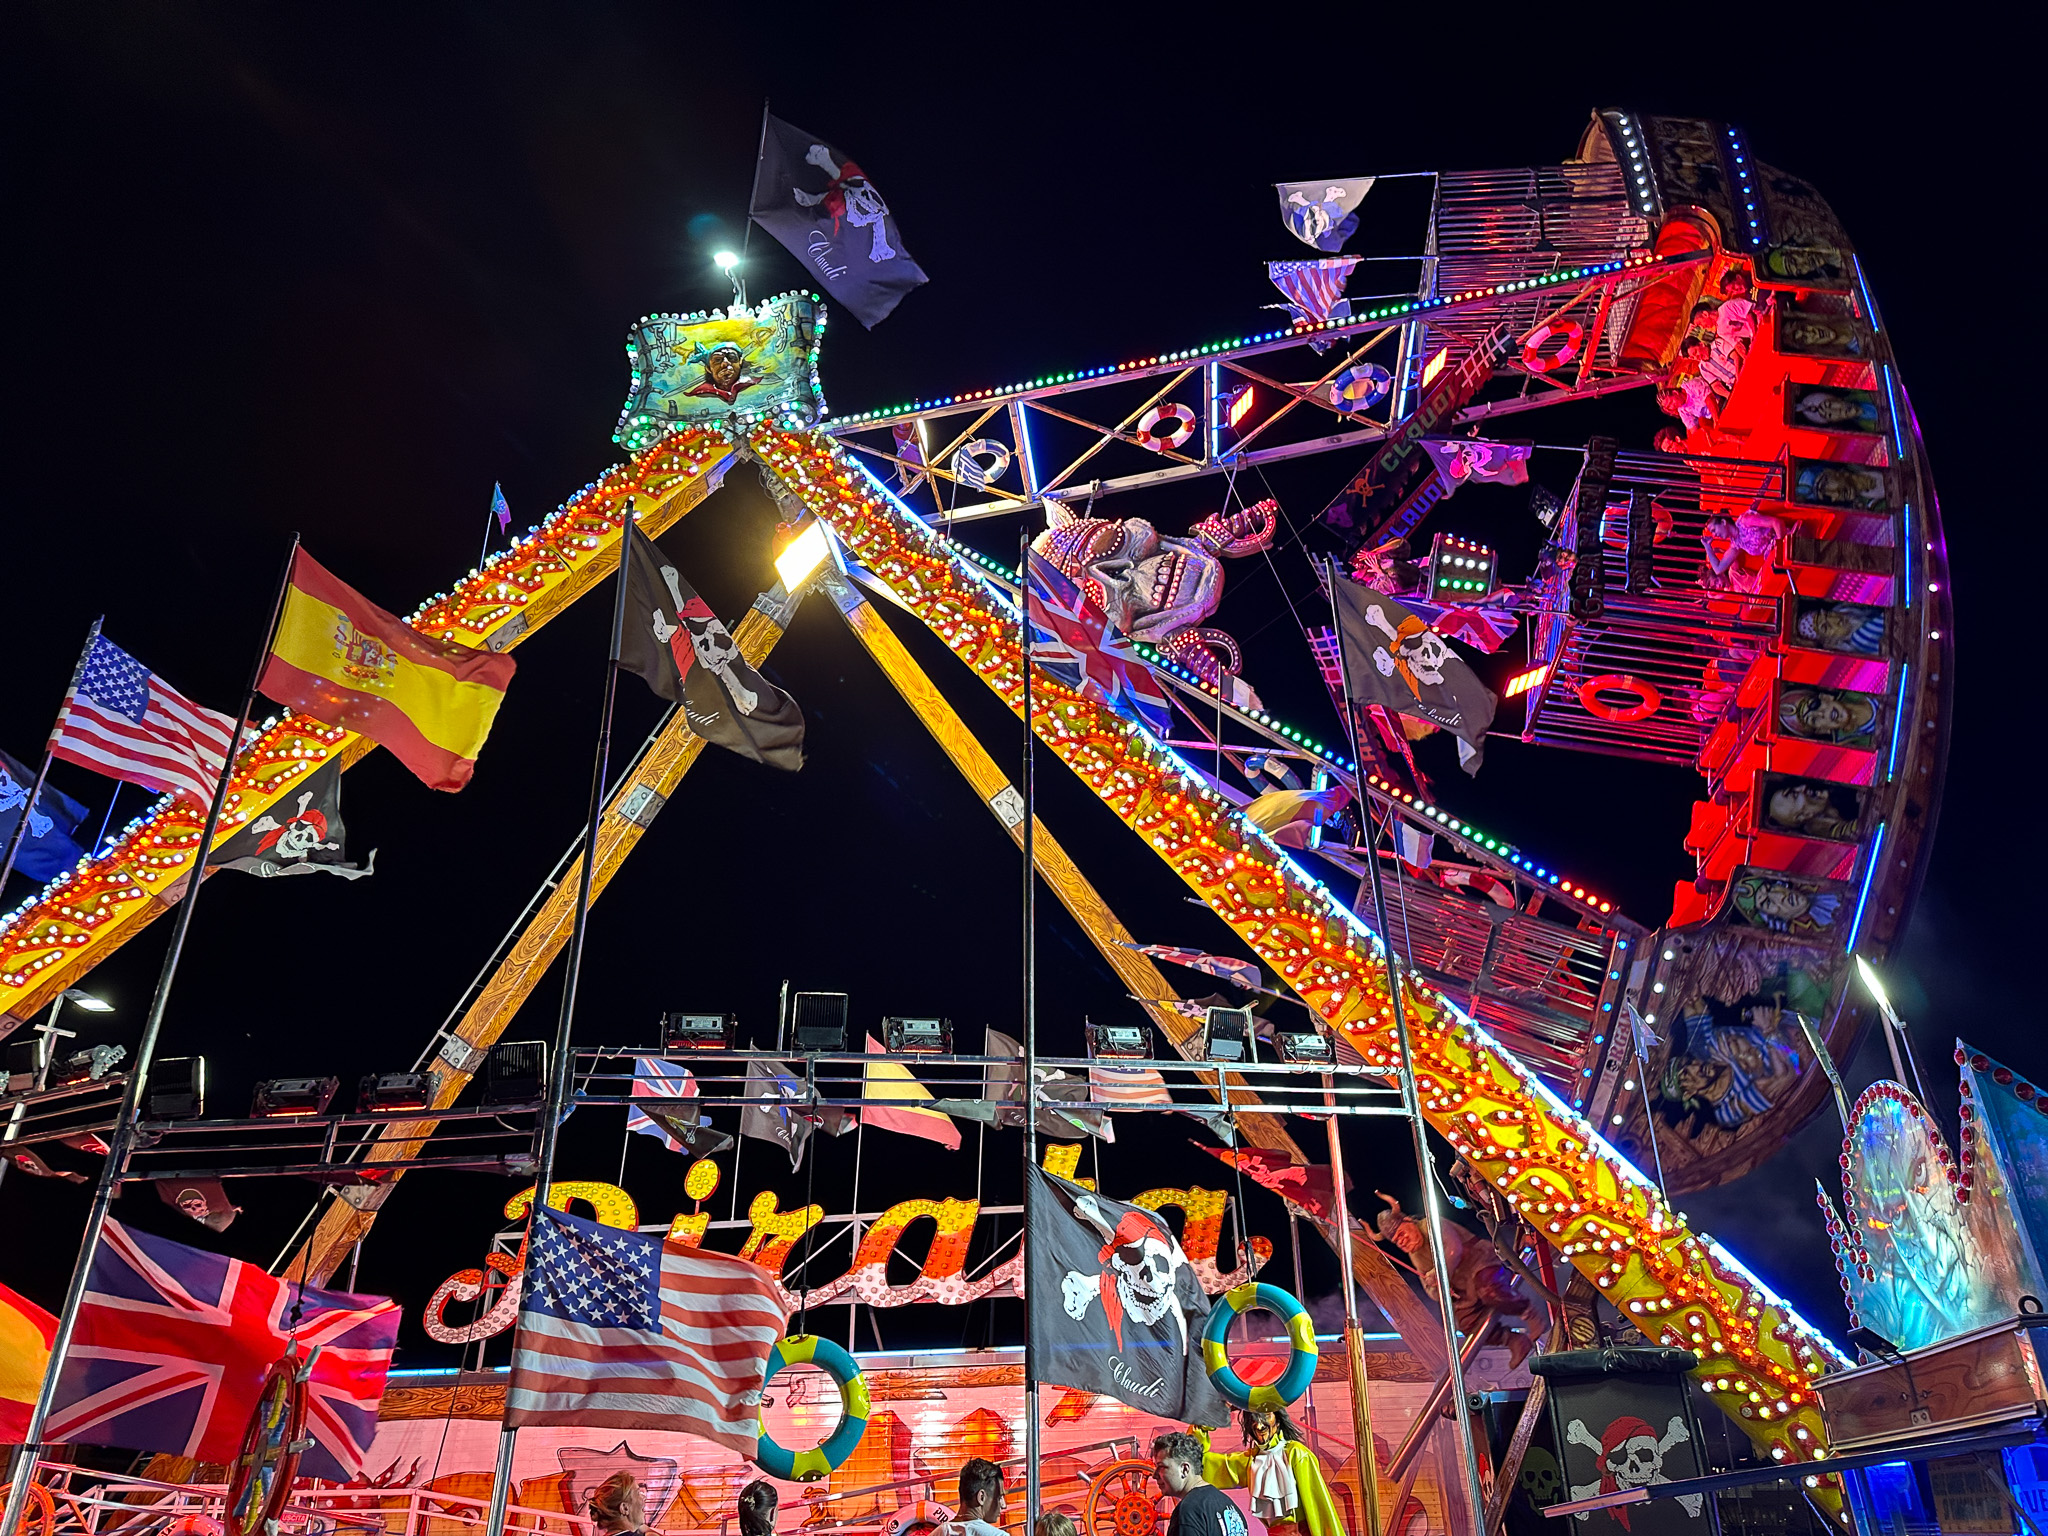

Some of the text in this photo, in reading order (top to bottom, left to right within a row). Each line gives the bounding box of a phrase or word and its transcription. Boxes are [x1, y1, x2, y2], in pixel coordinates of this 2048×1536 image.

[807, 229, 848, 281] Claudi
[1380, 384, 1455, 473] CLAUDI
[1107, 1355, 1165, 1399] Claudi
[281, 1513, 306, 1522] USCITA
